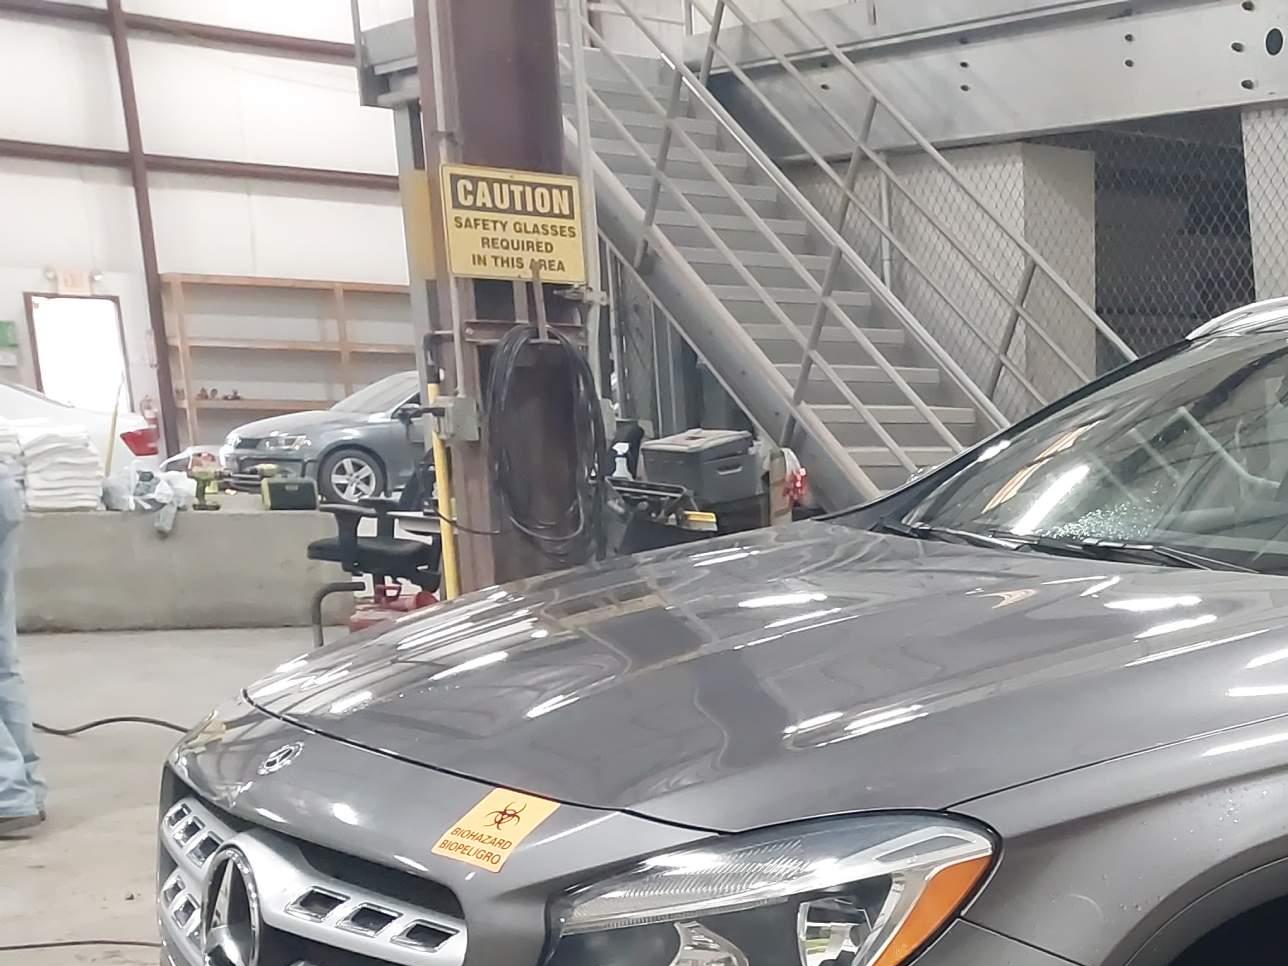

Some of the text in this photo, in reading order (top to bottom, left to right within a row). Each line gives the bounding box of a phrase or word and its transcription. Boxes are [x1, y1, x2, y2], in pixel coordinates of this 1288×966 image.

[456, 179, 570, 215] CAUTION
[454, 216, 576, 238] SAFETY GLASSES
[481, 237, 554, 253] REQUIRED
[472, 254, 487, 266] IN
[491, 255, 524, 269] THIS
[450, 827, 512, 850] BIOHAZARD
[439, 839, 502, 865] BIOPELIGRO
